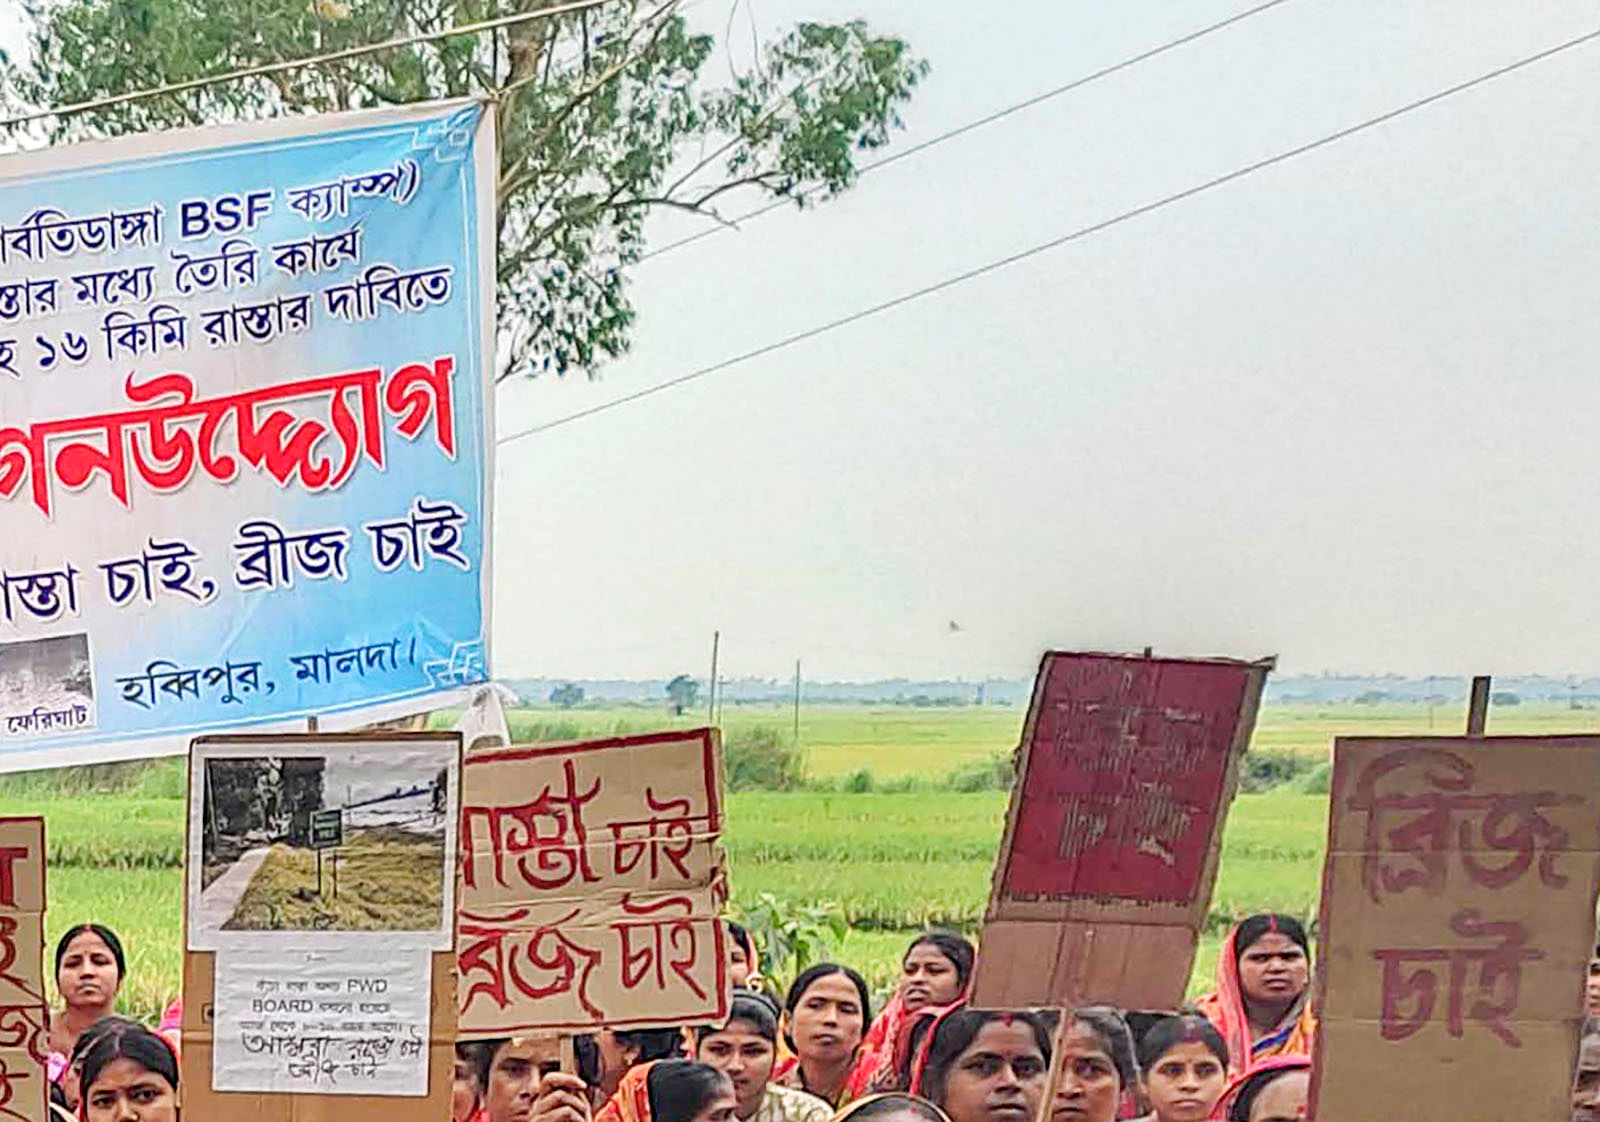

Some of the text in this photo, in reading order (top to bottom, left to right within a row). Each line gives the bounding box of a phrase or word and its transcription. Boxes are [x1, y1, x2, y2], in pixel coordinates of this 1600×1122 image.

[180, 192, 272, 238] BSF
[36, 331, 89, 369] ১৬
[101, 306, 188, 361] কিমি
[200, 294, 313, 346] রাস্তার
[324, 264, 453, 322] দাবিতে
[71, 264, 155, 306] মধ্যে
[175, 241, 260, 294] তৈরি
[99, 537, 216, 603] চাই,
[231, 519, 349, 590] ব্রীজ
[367, 500, 470, 569] চাই
[7, 703, 89, 735] ফেরিঘাট
[606, 786, 693, 880] চাই
[1349, 747, 1585, 903] ব্রিজ
[611, 891, 708, 1001] চাই
[1375, 907, 1546, 1049] চাই
[252, 998, 314, 1014] BOARD
